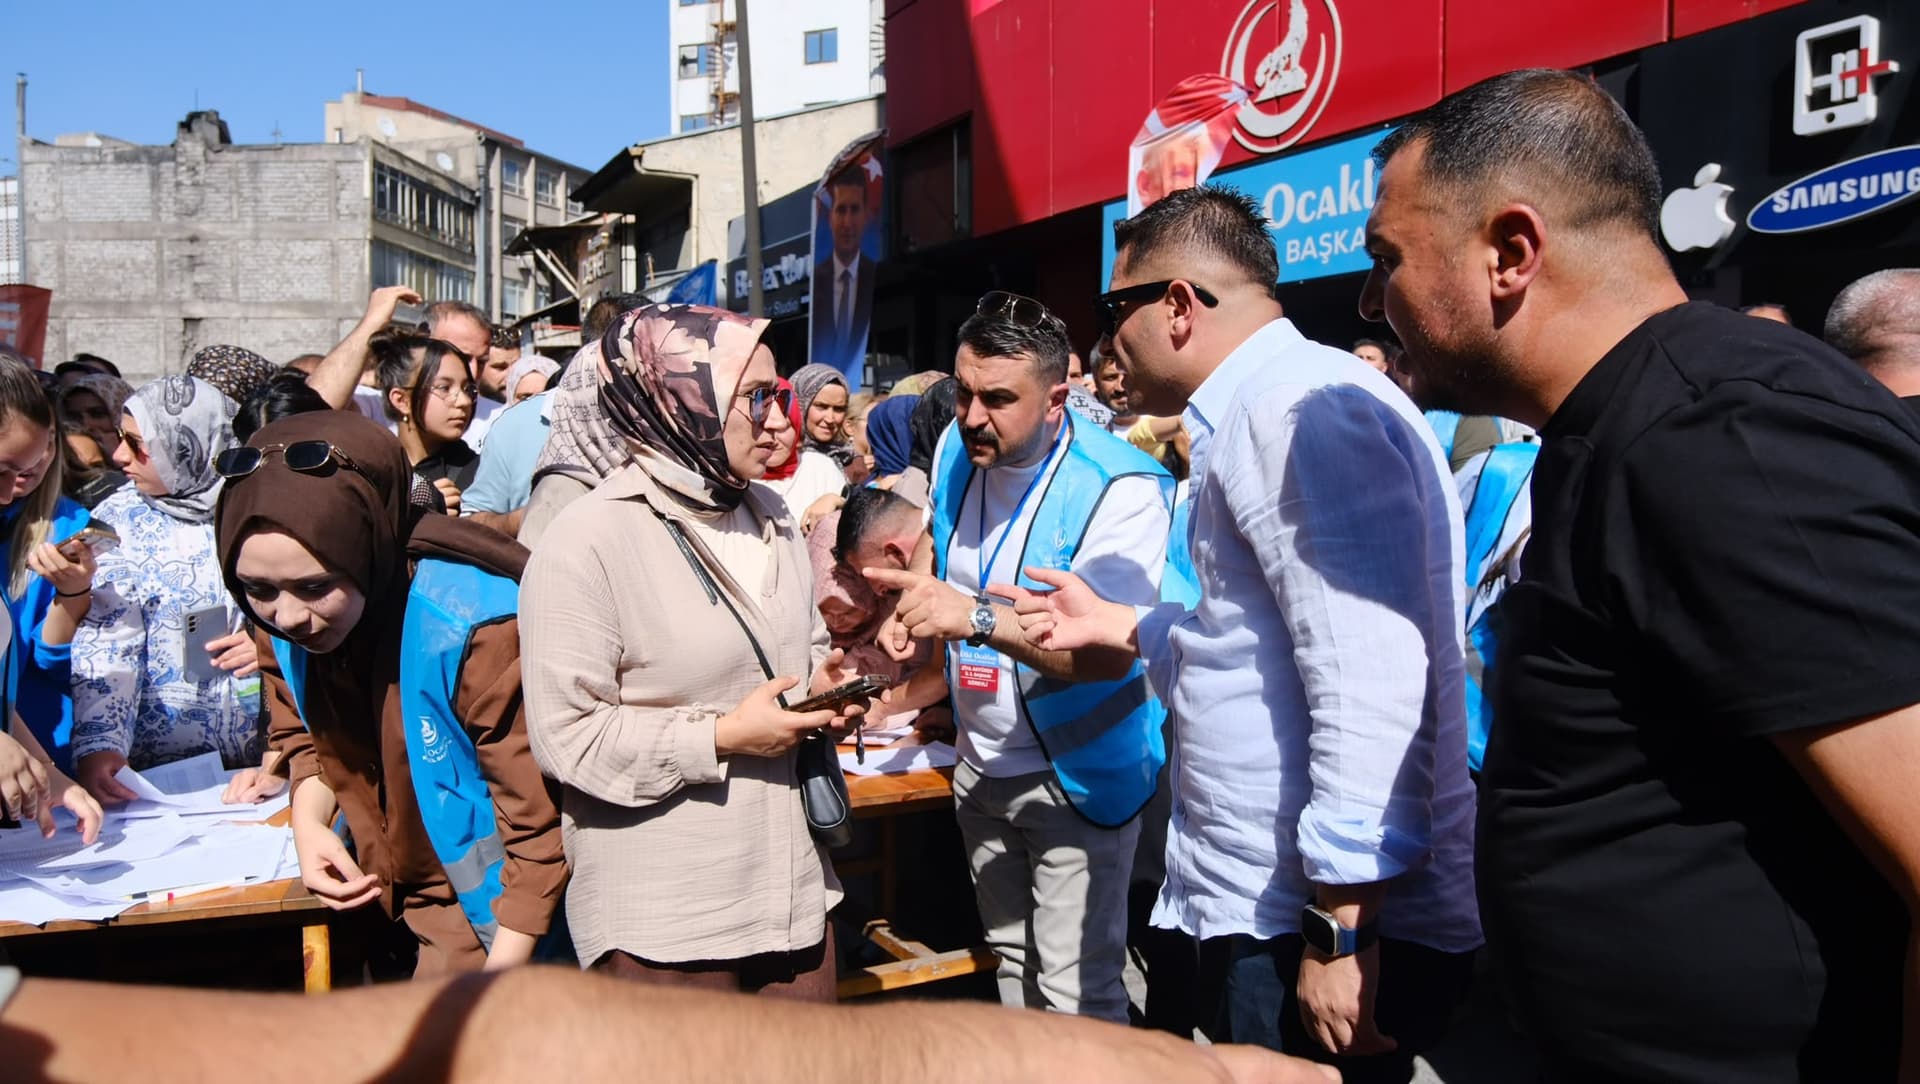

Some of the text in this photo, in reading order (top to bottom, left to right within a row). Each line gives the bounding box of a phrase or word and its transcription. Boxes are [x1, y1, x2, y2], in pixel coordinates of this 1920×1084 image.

[1262, 158, 1376, 230] Ocakl
[1771, 166, 1920, 213] SAMSUNG
[1286, 226, 1367, 264] BAŞKA
